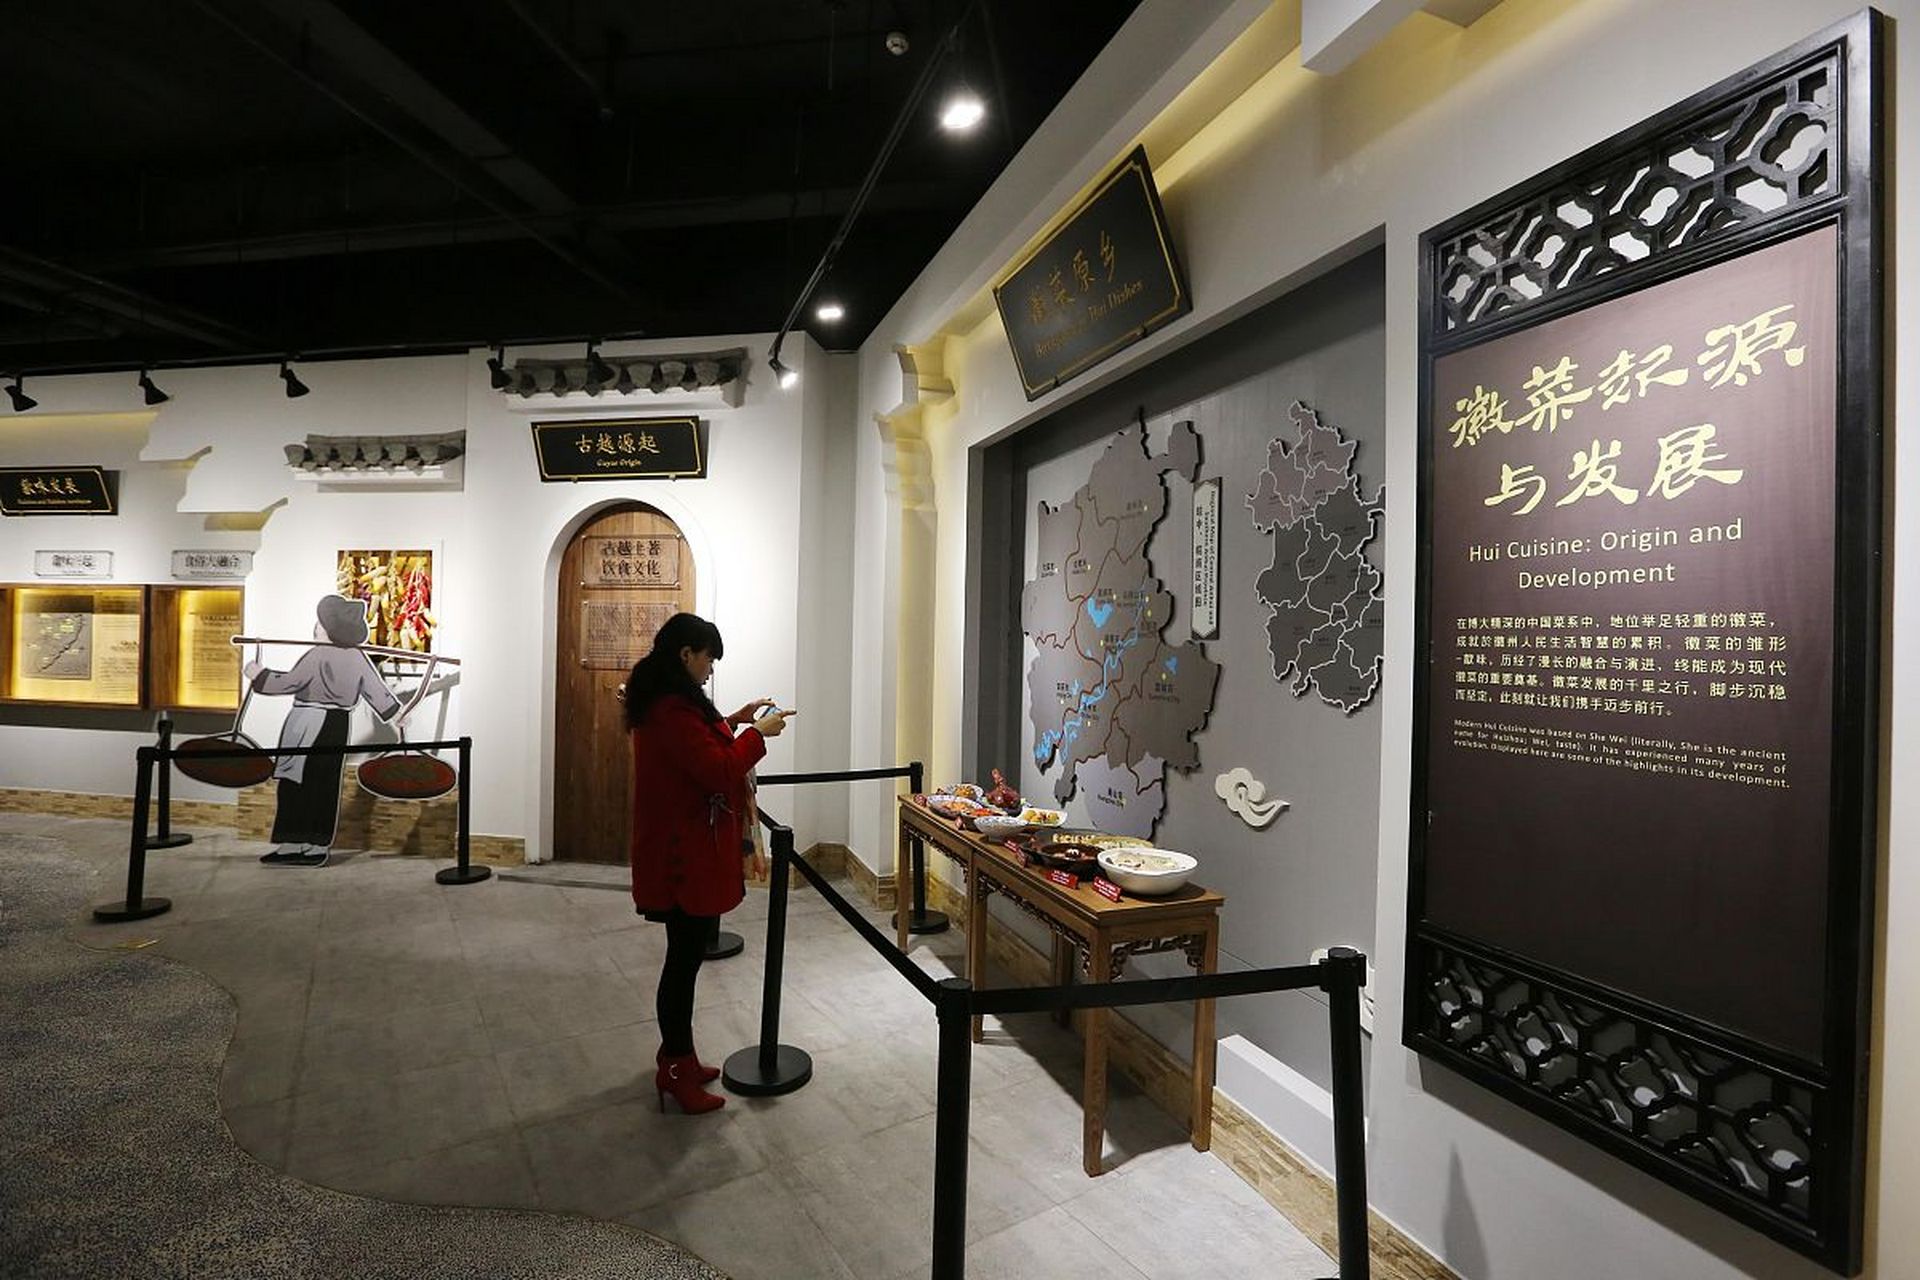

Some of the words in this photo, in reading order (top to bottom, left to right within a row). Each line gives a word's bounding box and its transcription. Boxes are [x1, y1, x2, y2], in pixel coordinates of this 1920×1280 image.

[1484, 423, 1744, 516] 与发展
[1469, 545, 1501, 562] Hui
[1507, 535, 1592, 560] Cuisine:
[1600, 529, 1678, 554] Origin
[1689, 518, 1744, 544] and
[1518, 562, 1676, 591] Development
[1547, 729, 1573, 739] based
[1575, 732, 1587, 740] on
[1680, 741, 1700, 752] She
[1703, 743, 1713, 753] is
[1717, 745, 1737, 756] the
[1740, 750, 1786, 761] ancient
[1602, 744, 1618, 755] has
[1625, 748, 1688, 763] experienced
[1695, 756, 1725, 769] many
[1732, 761, 1765, 772] years
[1773, 764, 1786, 775] of
[1551, 751, 1565, 759] are
[1567, 752, 1591, 762] some
[1593, 755, 1603, 764] of
[1605, 756, 1622, 767] the
[1623, 759, 1674, 774] highlights
[1677, 765, 1687, 775] in
[1690, 767, 1705, 777] its
[1708, 769, 1790, 788] development.
